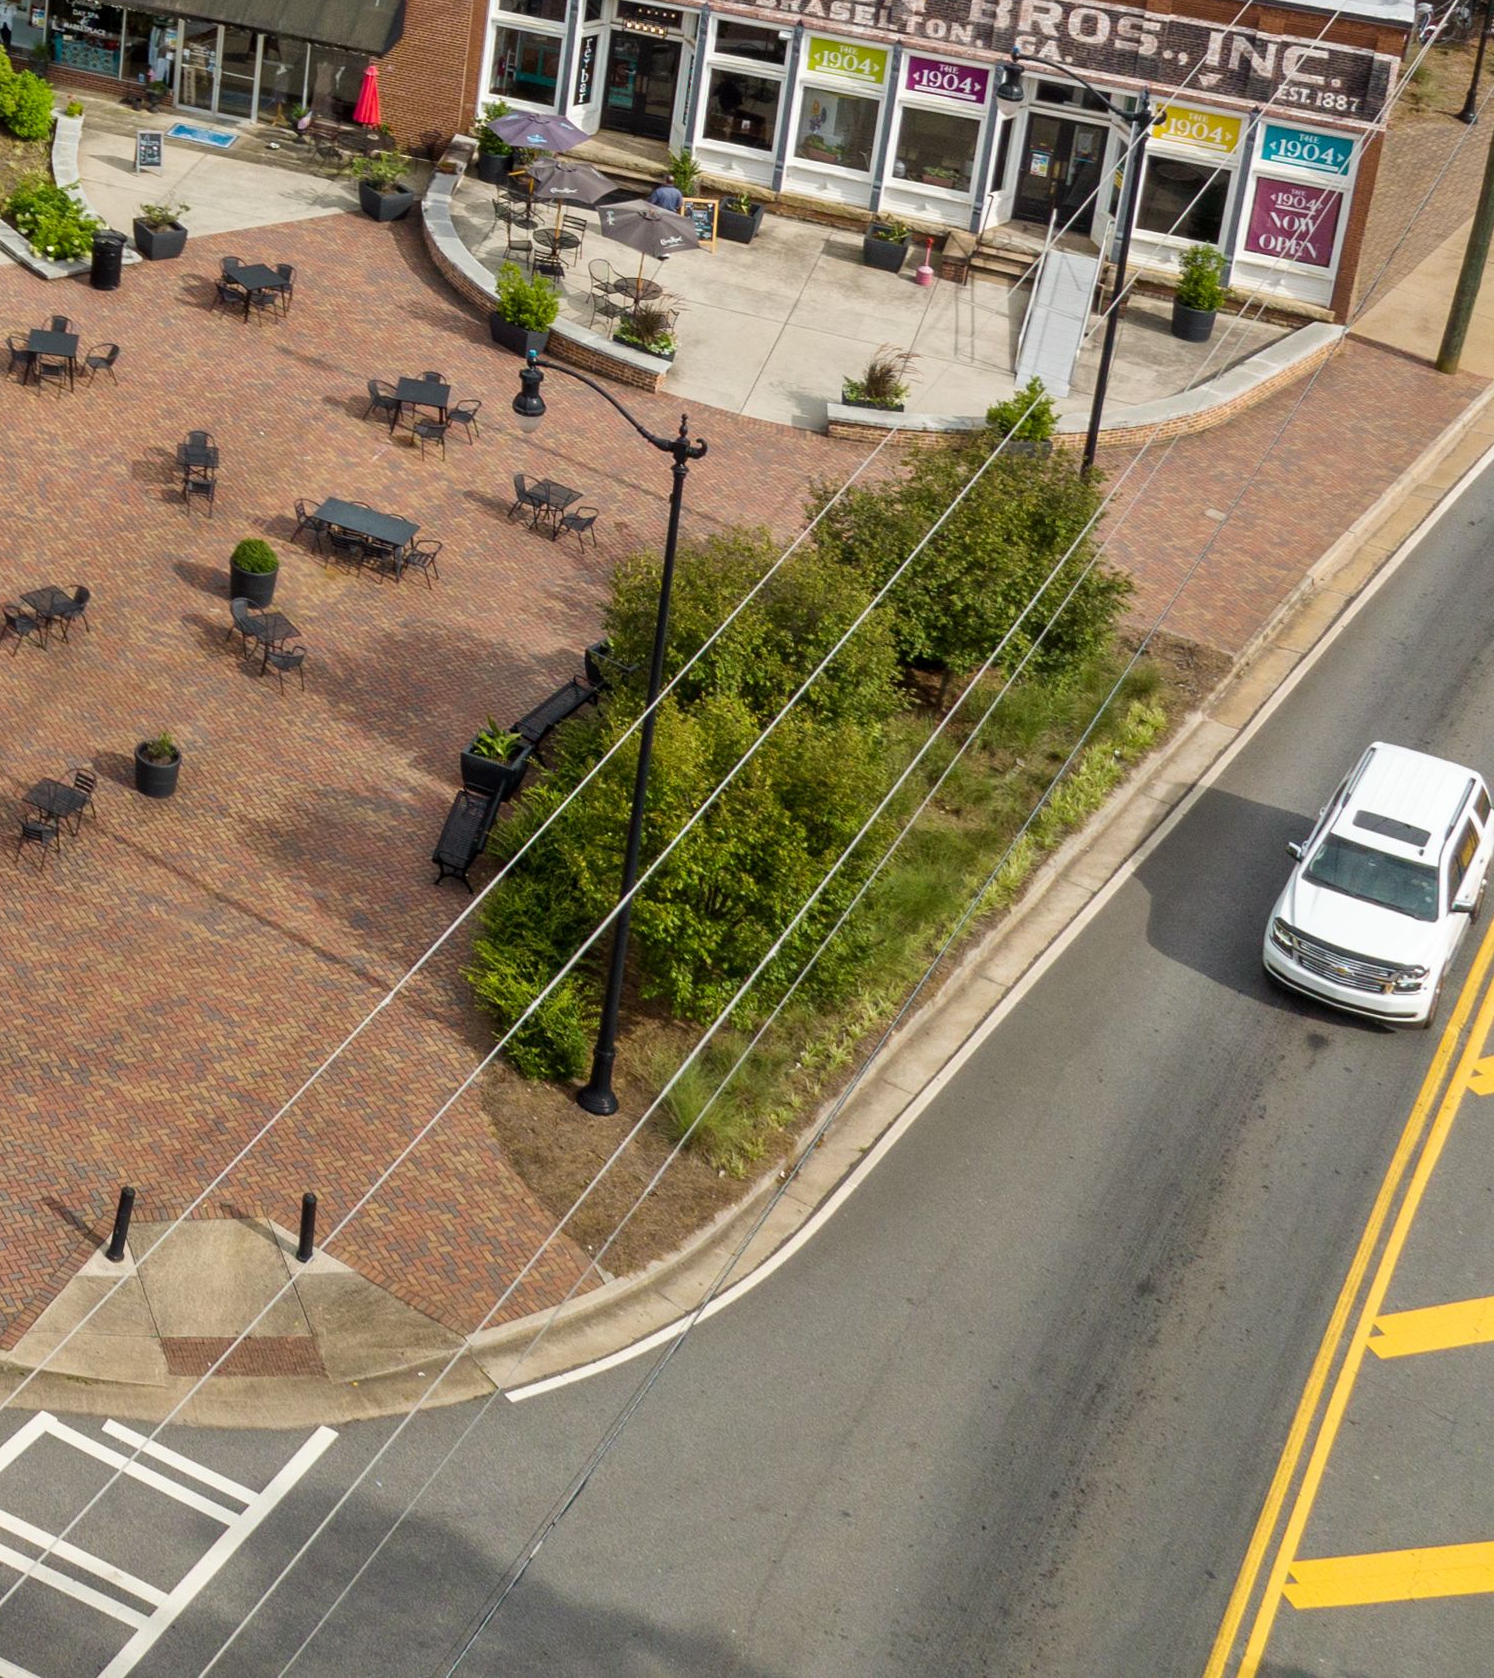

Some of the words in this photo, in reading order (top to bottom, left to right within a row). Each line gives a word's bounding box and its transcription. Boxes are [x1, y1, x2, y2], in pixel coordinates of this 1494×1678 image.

[839, 45, 858, 55] THE
[1015, 35, 1074, 64] GA.
[1207, 31, 1343, 88] INC.
[821, 50, 871, 74] 1904
[939, 64, 959, 75] THE
[921, 69, 972, 94] 1904
[1278, 85, 1311, 104] EST.
[1312, 91, 1360, 112] 1887
[1169, 117, 1223, 142] 1904
[1189, 112, 1209, 123] THE
[1299, 133, 1320, 144] THE
[1278, 138, 1334, 164] 1904
[1276, 192, 1316, 209] 1904
[1268, 211, 1316, 233] NOW
[1258, 233, 1318, 258] OPEN
